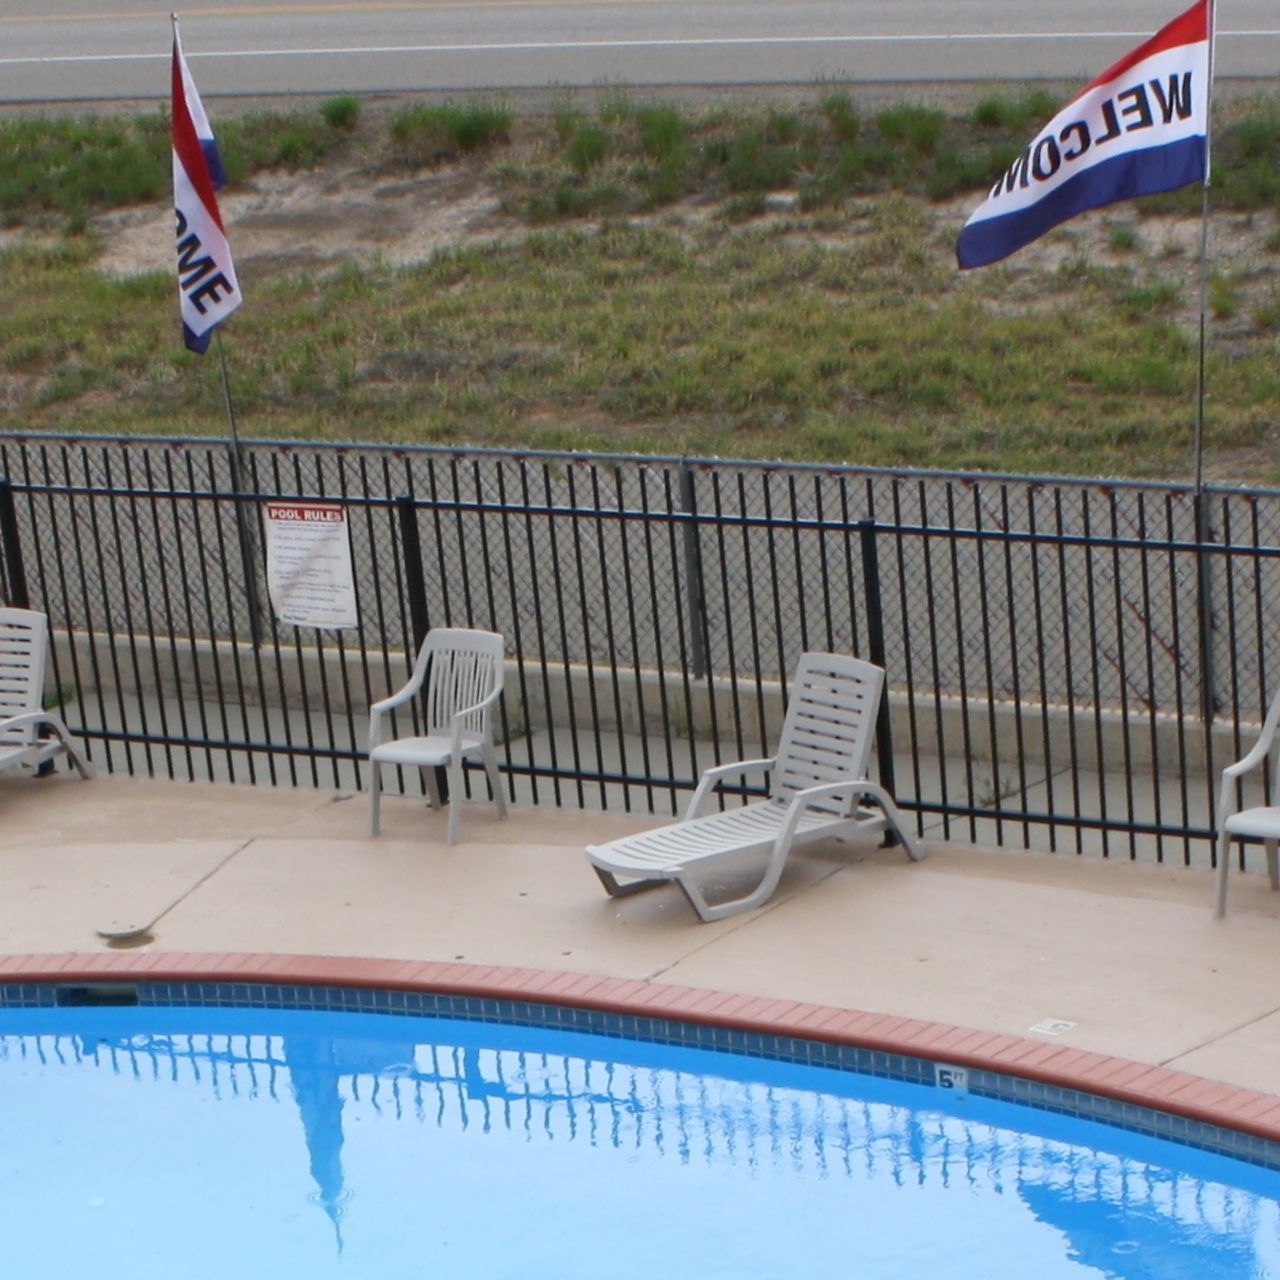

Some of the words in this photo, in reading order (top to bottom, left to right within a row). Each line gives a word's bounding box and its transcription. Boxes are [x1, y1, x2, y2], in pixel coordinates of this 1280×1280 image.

[271, 509, 301, 519] POOL
[304, 510, 342, 522] RULES
[939, 1069, 954, 1089] 5
